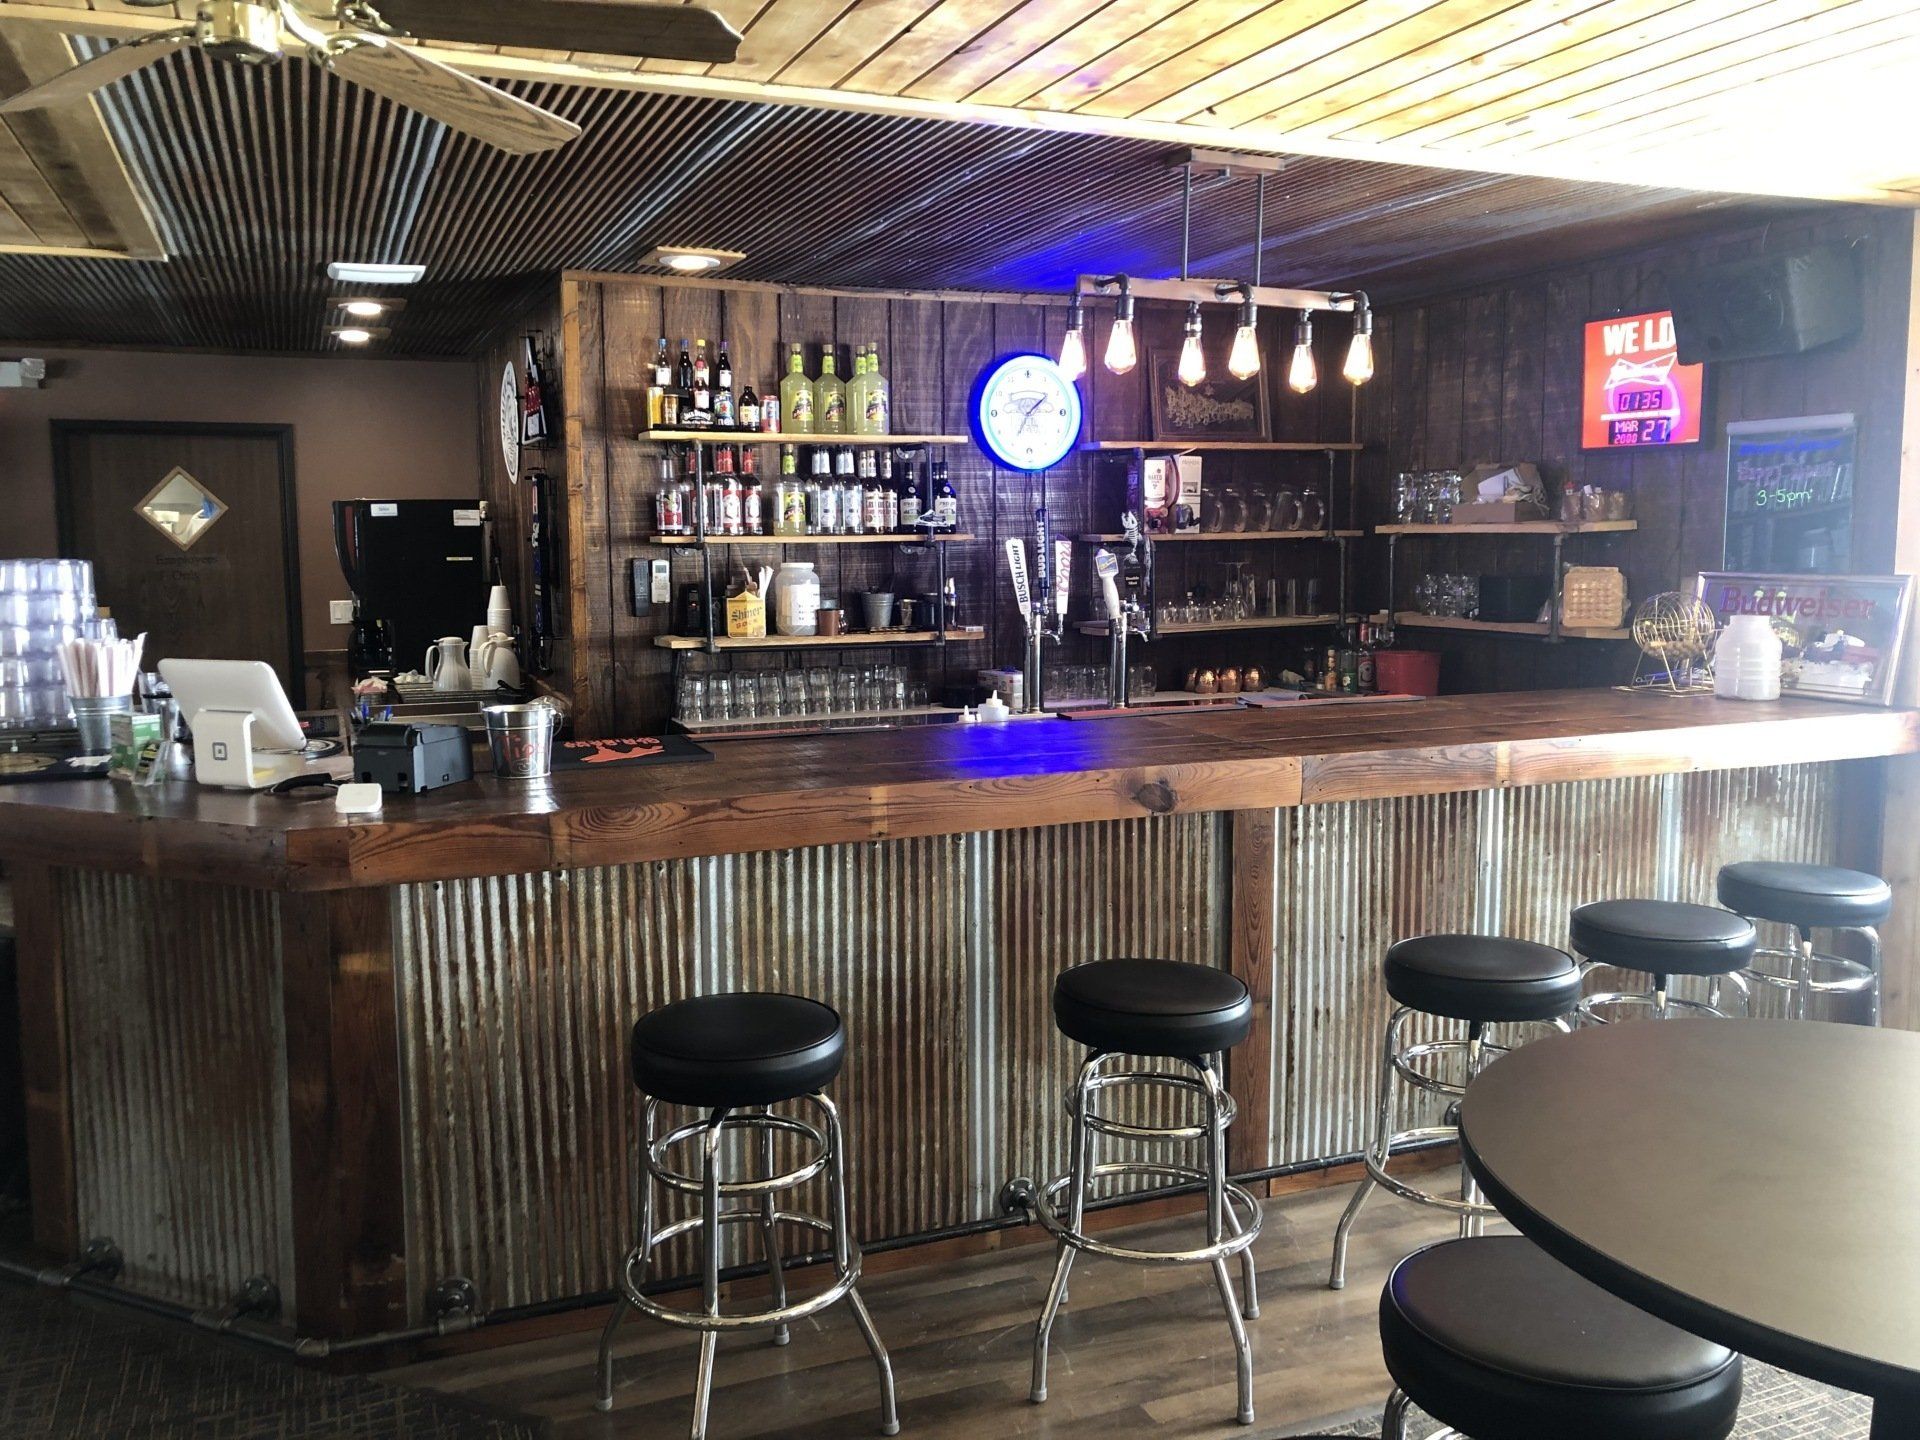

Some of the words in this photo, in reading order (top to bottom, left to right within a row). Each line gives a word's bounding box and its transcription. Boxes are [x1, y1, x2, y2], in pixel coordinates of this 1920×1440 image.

[1603, 321, 1640, 356] WE
[1614, 419, 1639, 434] MAR
[1642, 418, 1669, 441] 27
[1037, 520, 1046, 553] LIGHT
[1011, 544, 1022, 570] LIGHT
[1037, 554, 1046, 578] BUD
[1056, 541, 1071, 593] Coors
[1014, 571, 1029, 603] BUSCH
[1720, 586, 1875, 618] Budweiser
